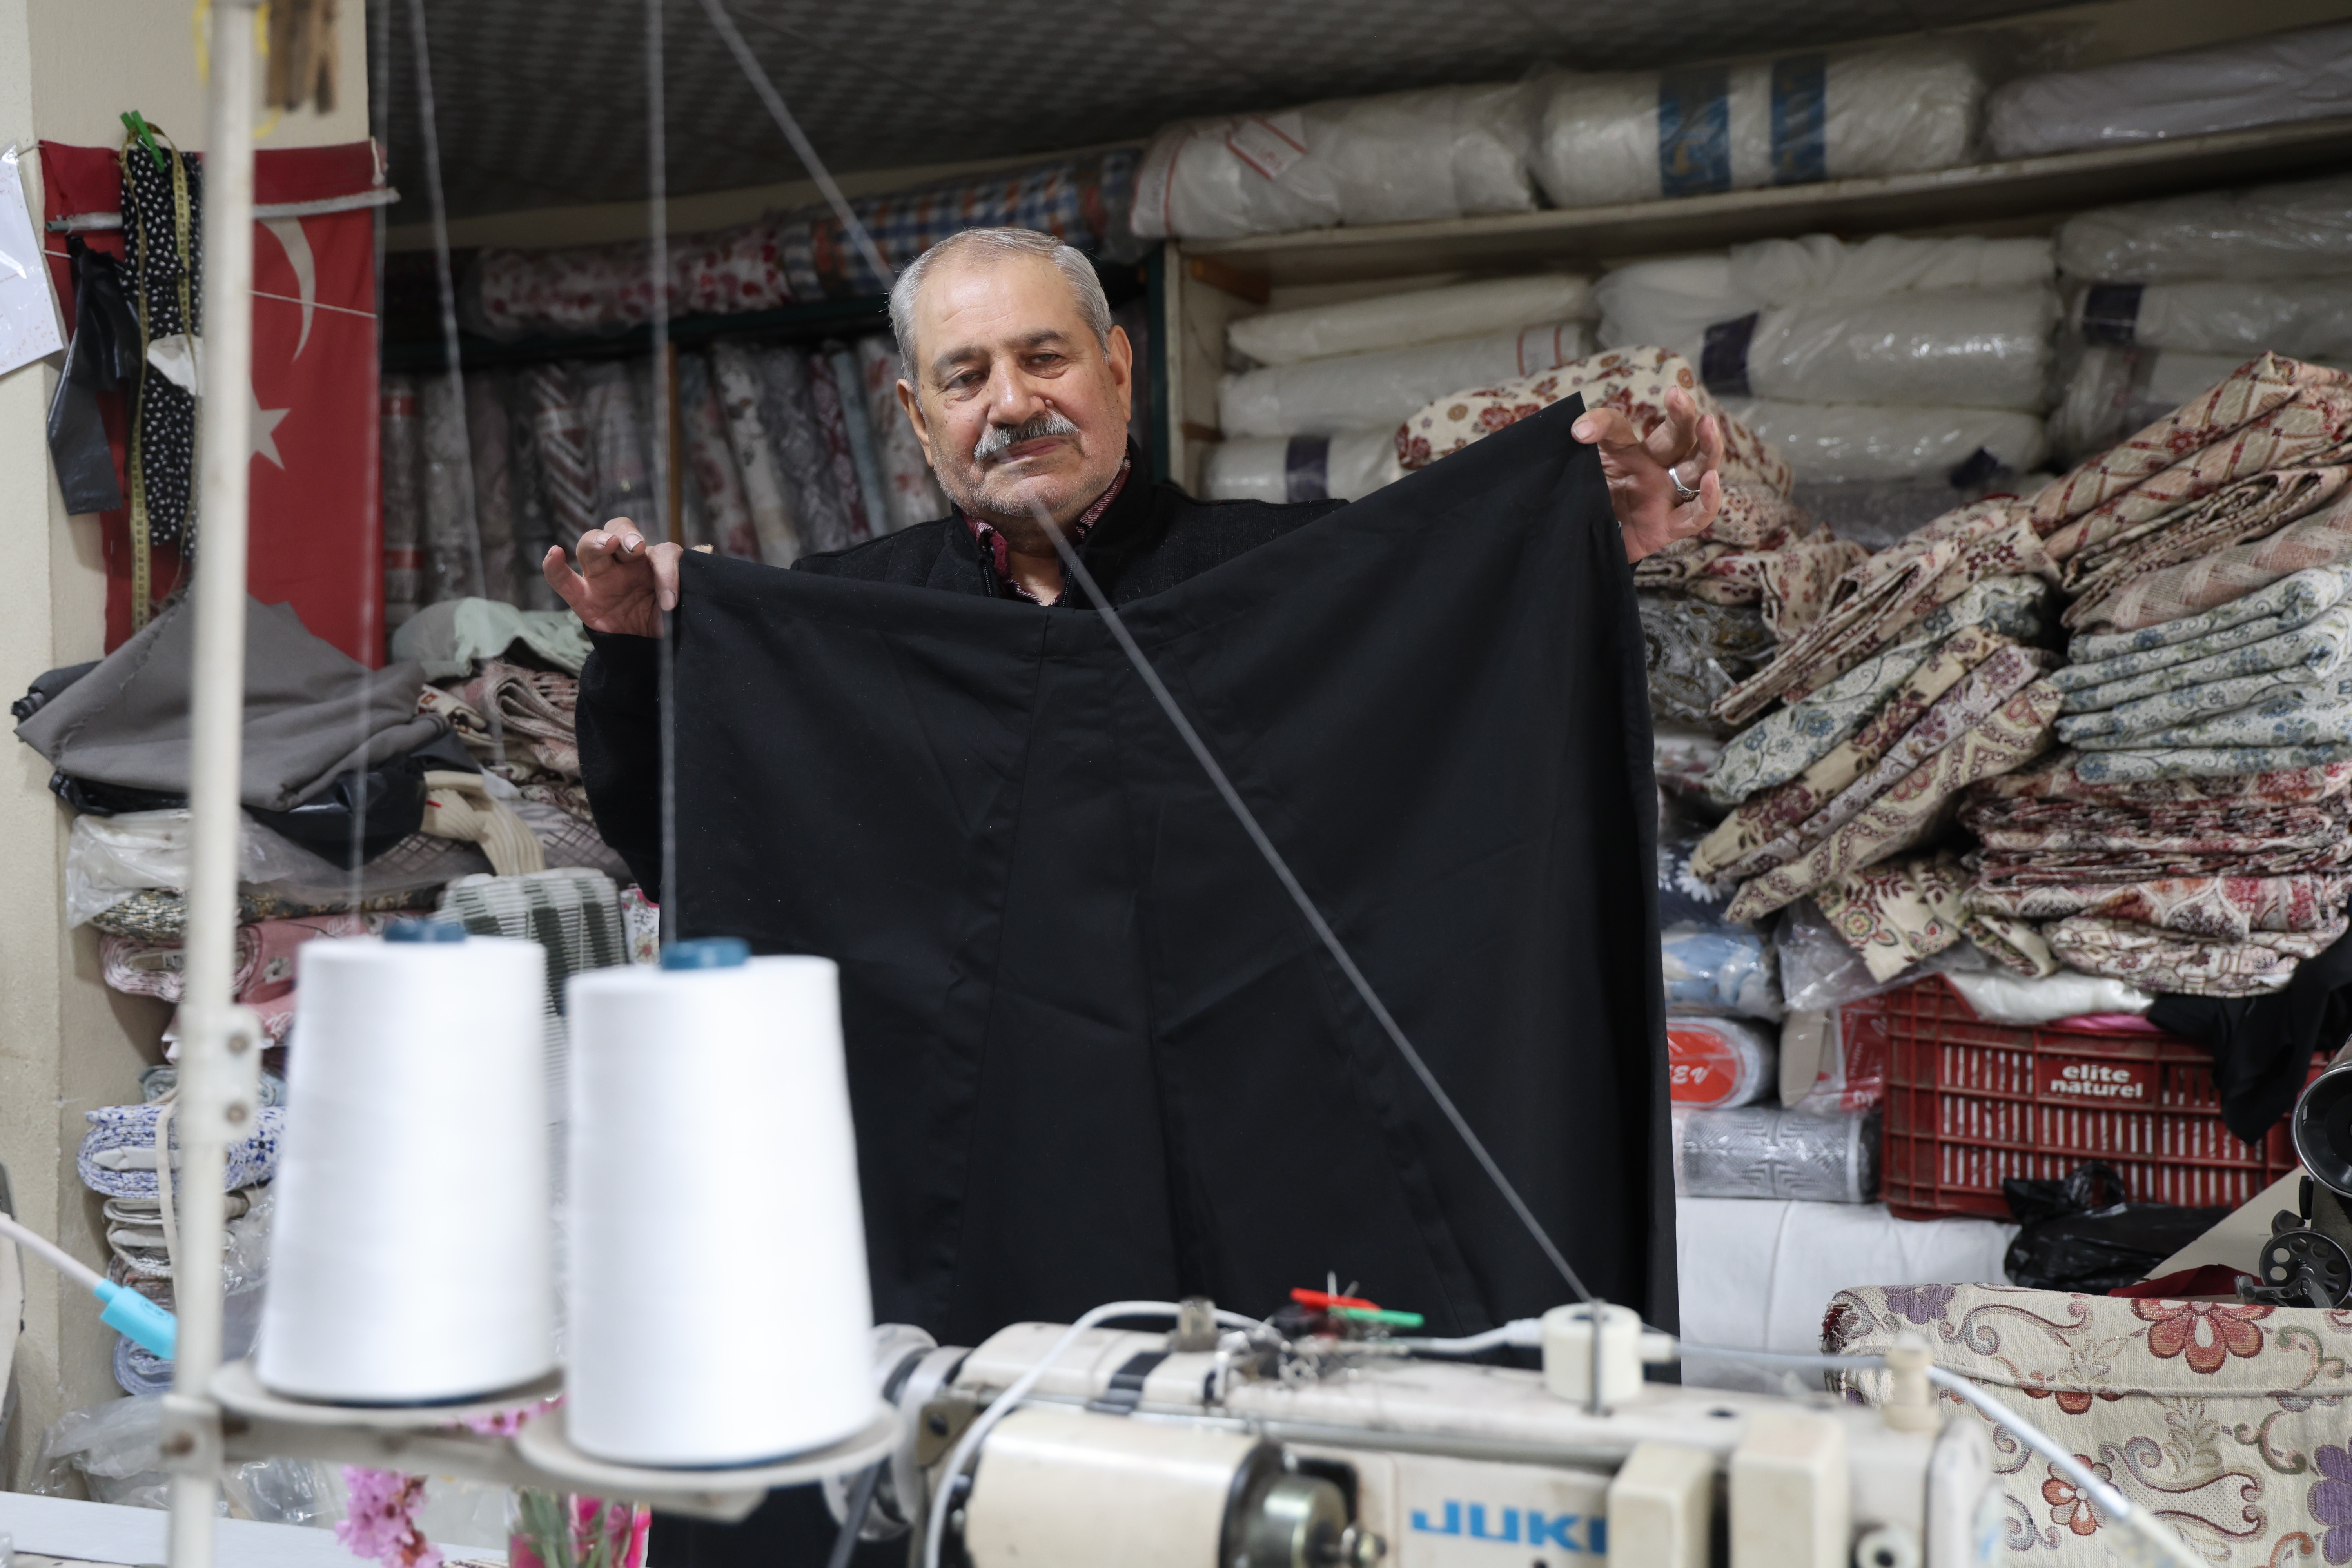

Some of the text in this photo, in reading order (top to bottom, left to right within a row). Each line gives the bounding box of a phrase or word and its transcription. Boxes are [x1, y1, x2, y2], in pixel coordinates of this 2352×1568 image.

[1669, 1064, 1710, 1085] EV
[2062, 1064, 2131, 1083] elite
[2050, 1079, 2144, 1098] naturel
[1410, 1501, 1606, 1555] JUKI
